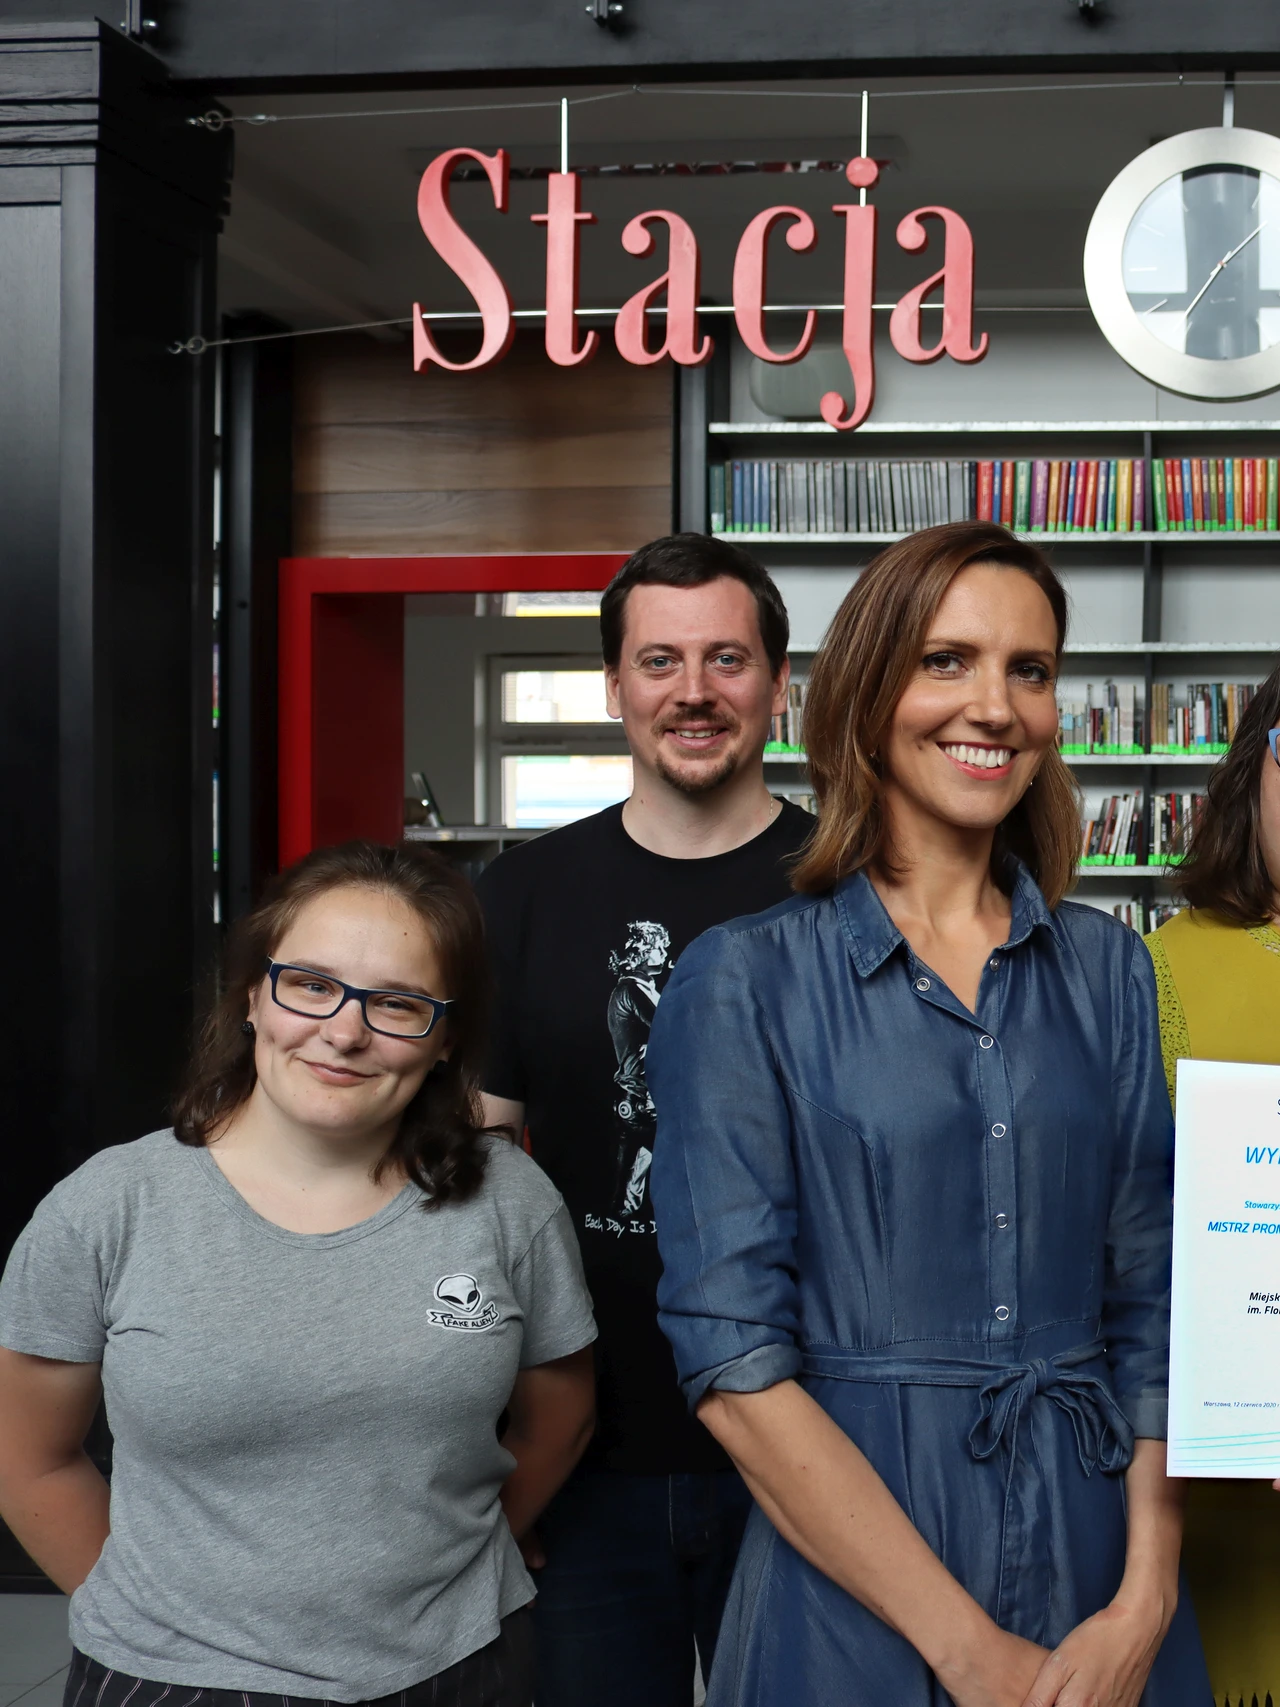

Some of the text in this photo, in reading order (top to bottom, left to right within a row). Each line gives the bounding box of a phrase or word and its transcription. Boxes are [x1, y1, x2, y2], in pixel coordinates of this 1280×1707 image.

[413, 147, 990, 431] Stacja
[585, 1213, 604, 1232] Each
[606, 1217, 626, 1239] Day
[630, 1220, 646, 1233] Is
[1207, 1221, 1250, 1234] MISTRZ
[1247, 1305, 1262, 1314] im.
[447, 1317, 492, 1328] FAKE ALIEN
